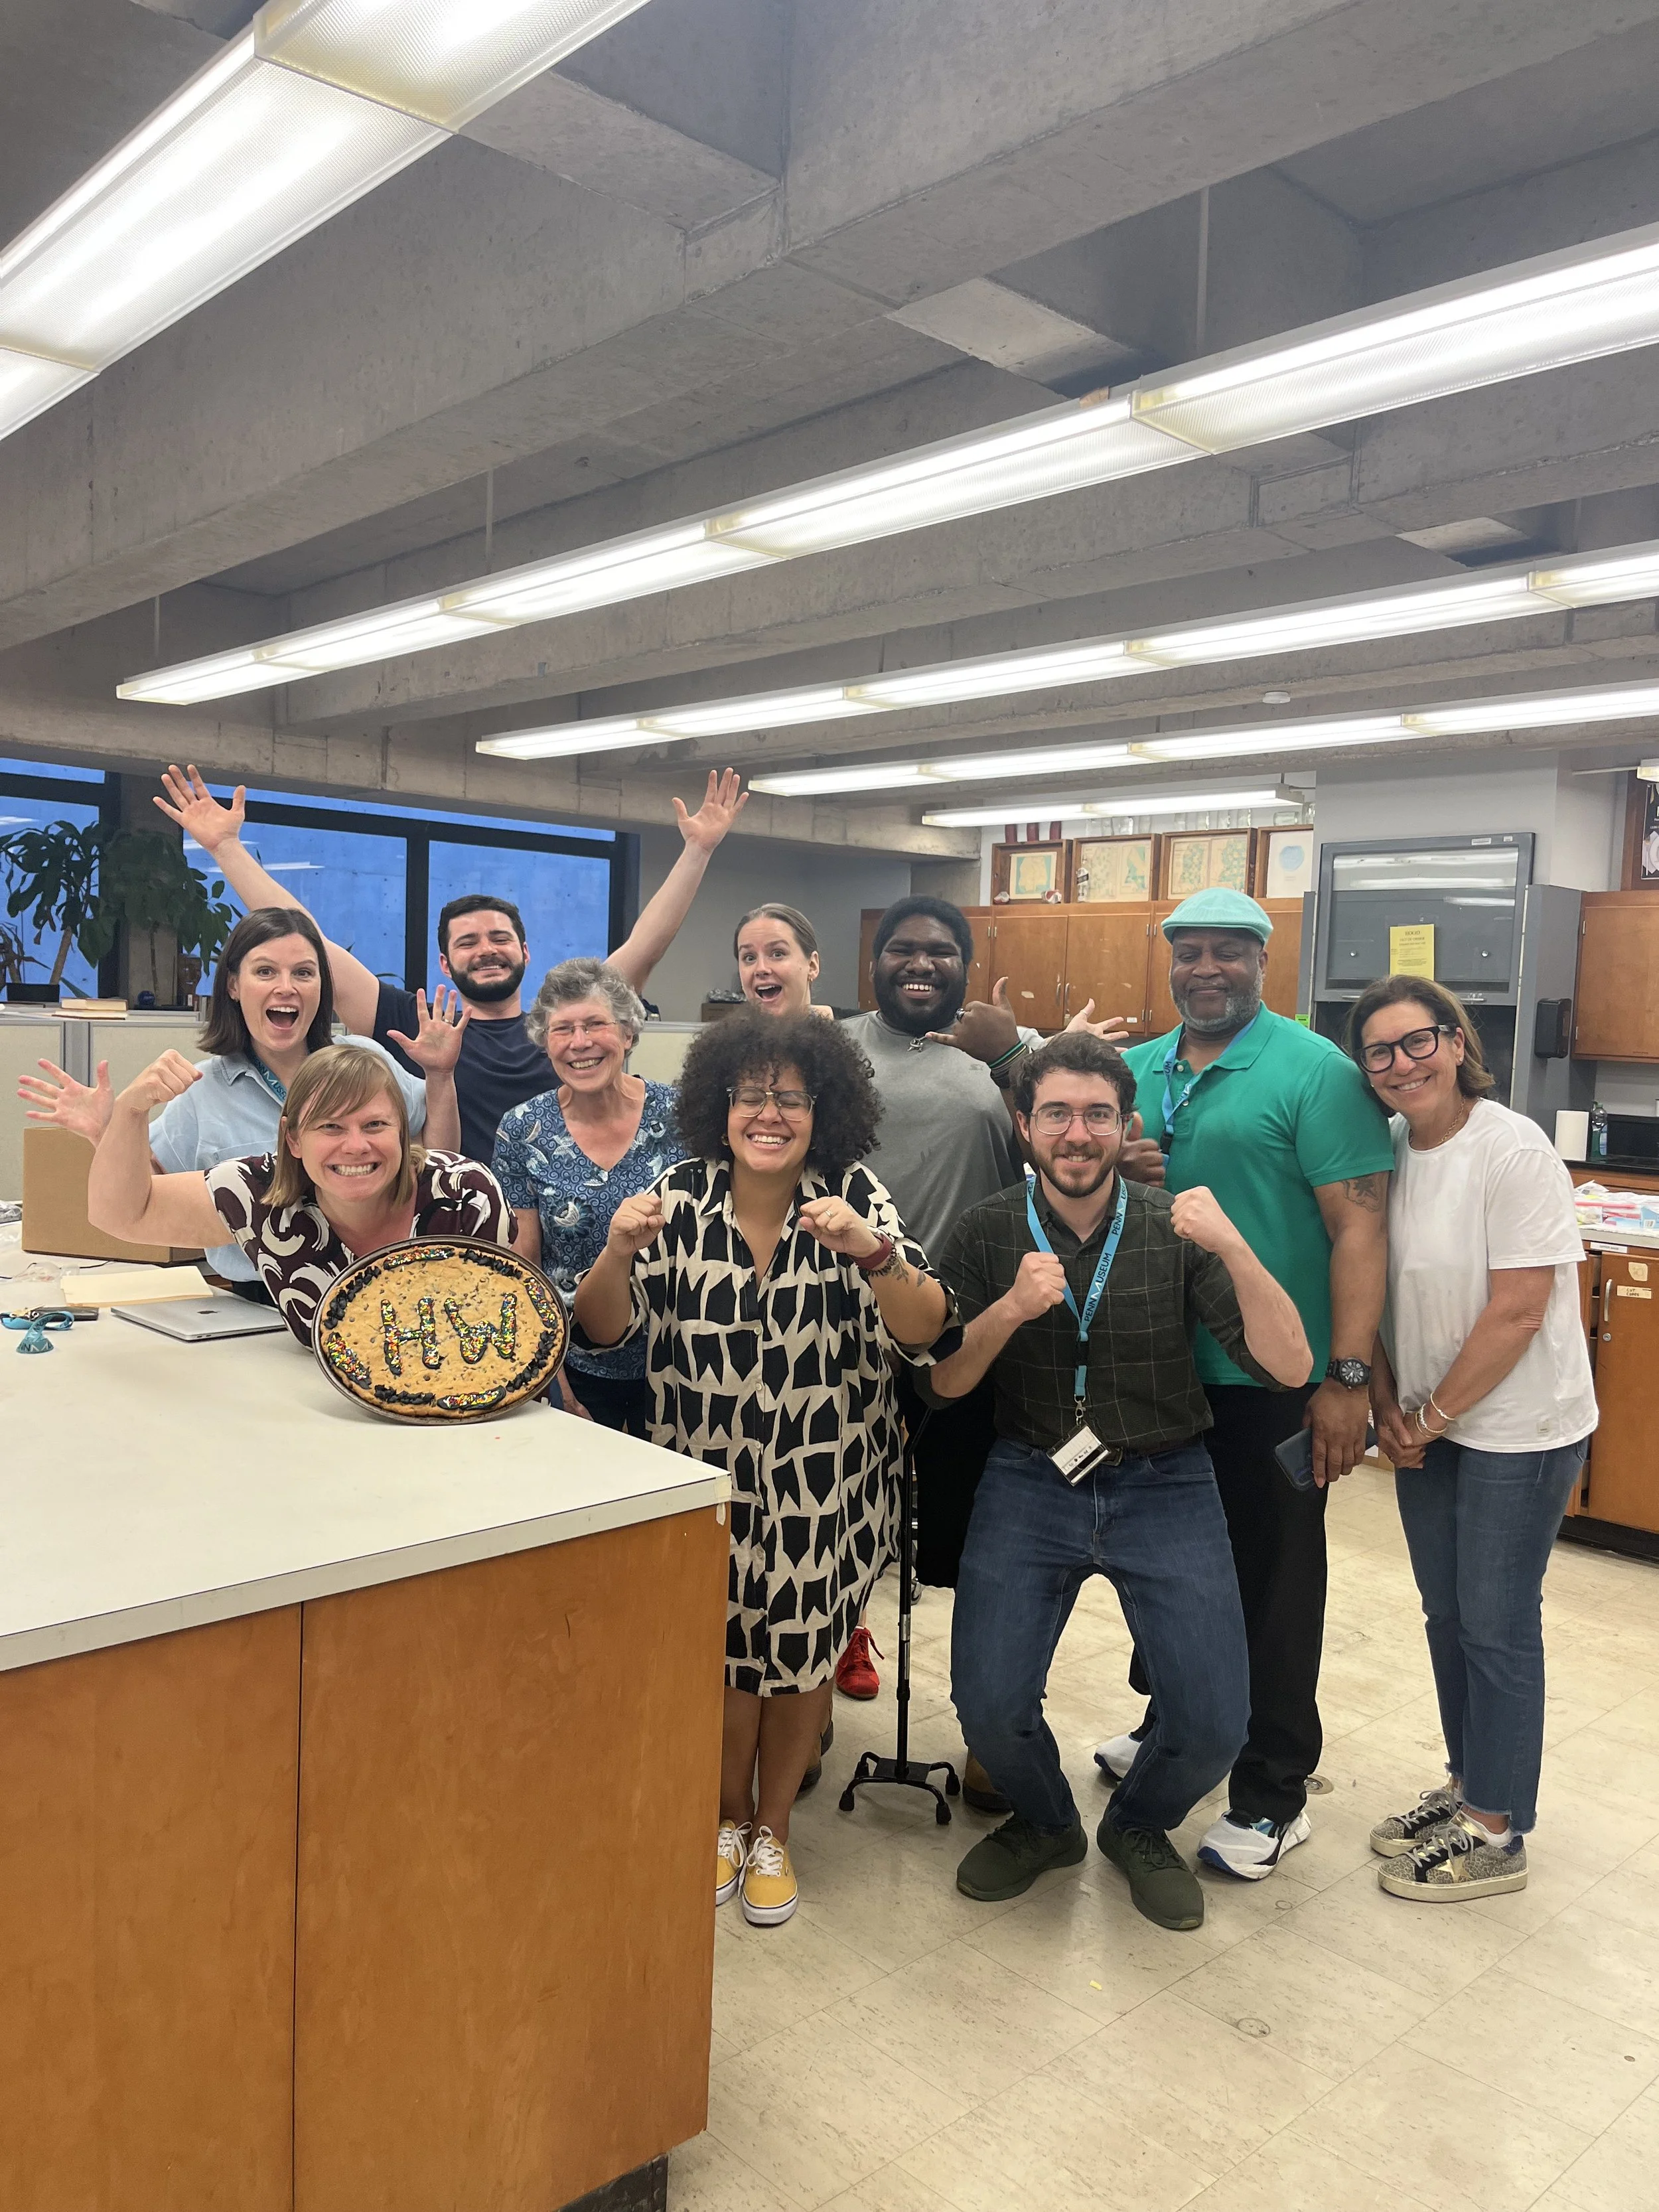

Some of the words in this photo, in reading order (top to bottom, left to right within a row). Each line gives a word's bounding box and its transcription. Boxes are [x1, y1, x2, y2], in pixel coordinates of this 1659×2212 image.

[1112, 1212, 1123, 1235] PENN
[1090, 1252, 1112, 1299] MUSEUM
[1084, 1297, 1098, 1322] PENN
